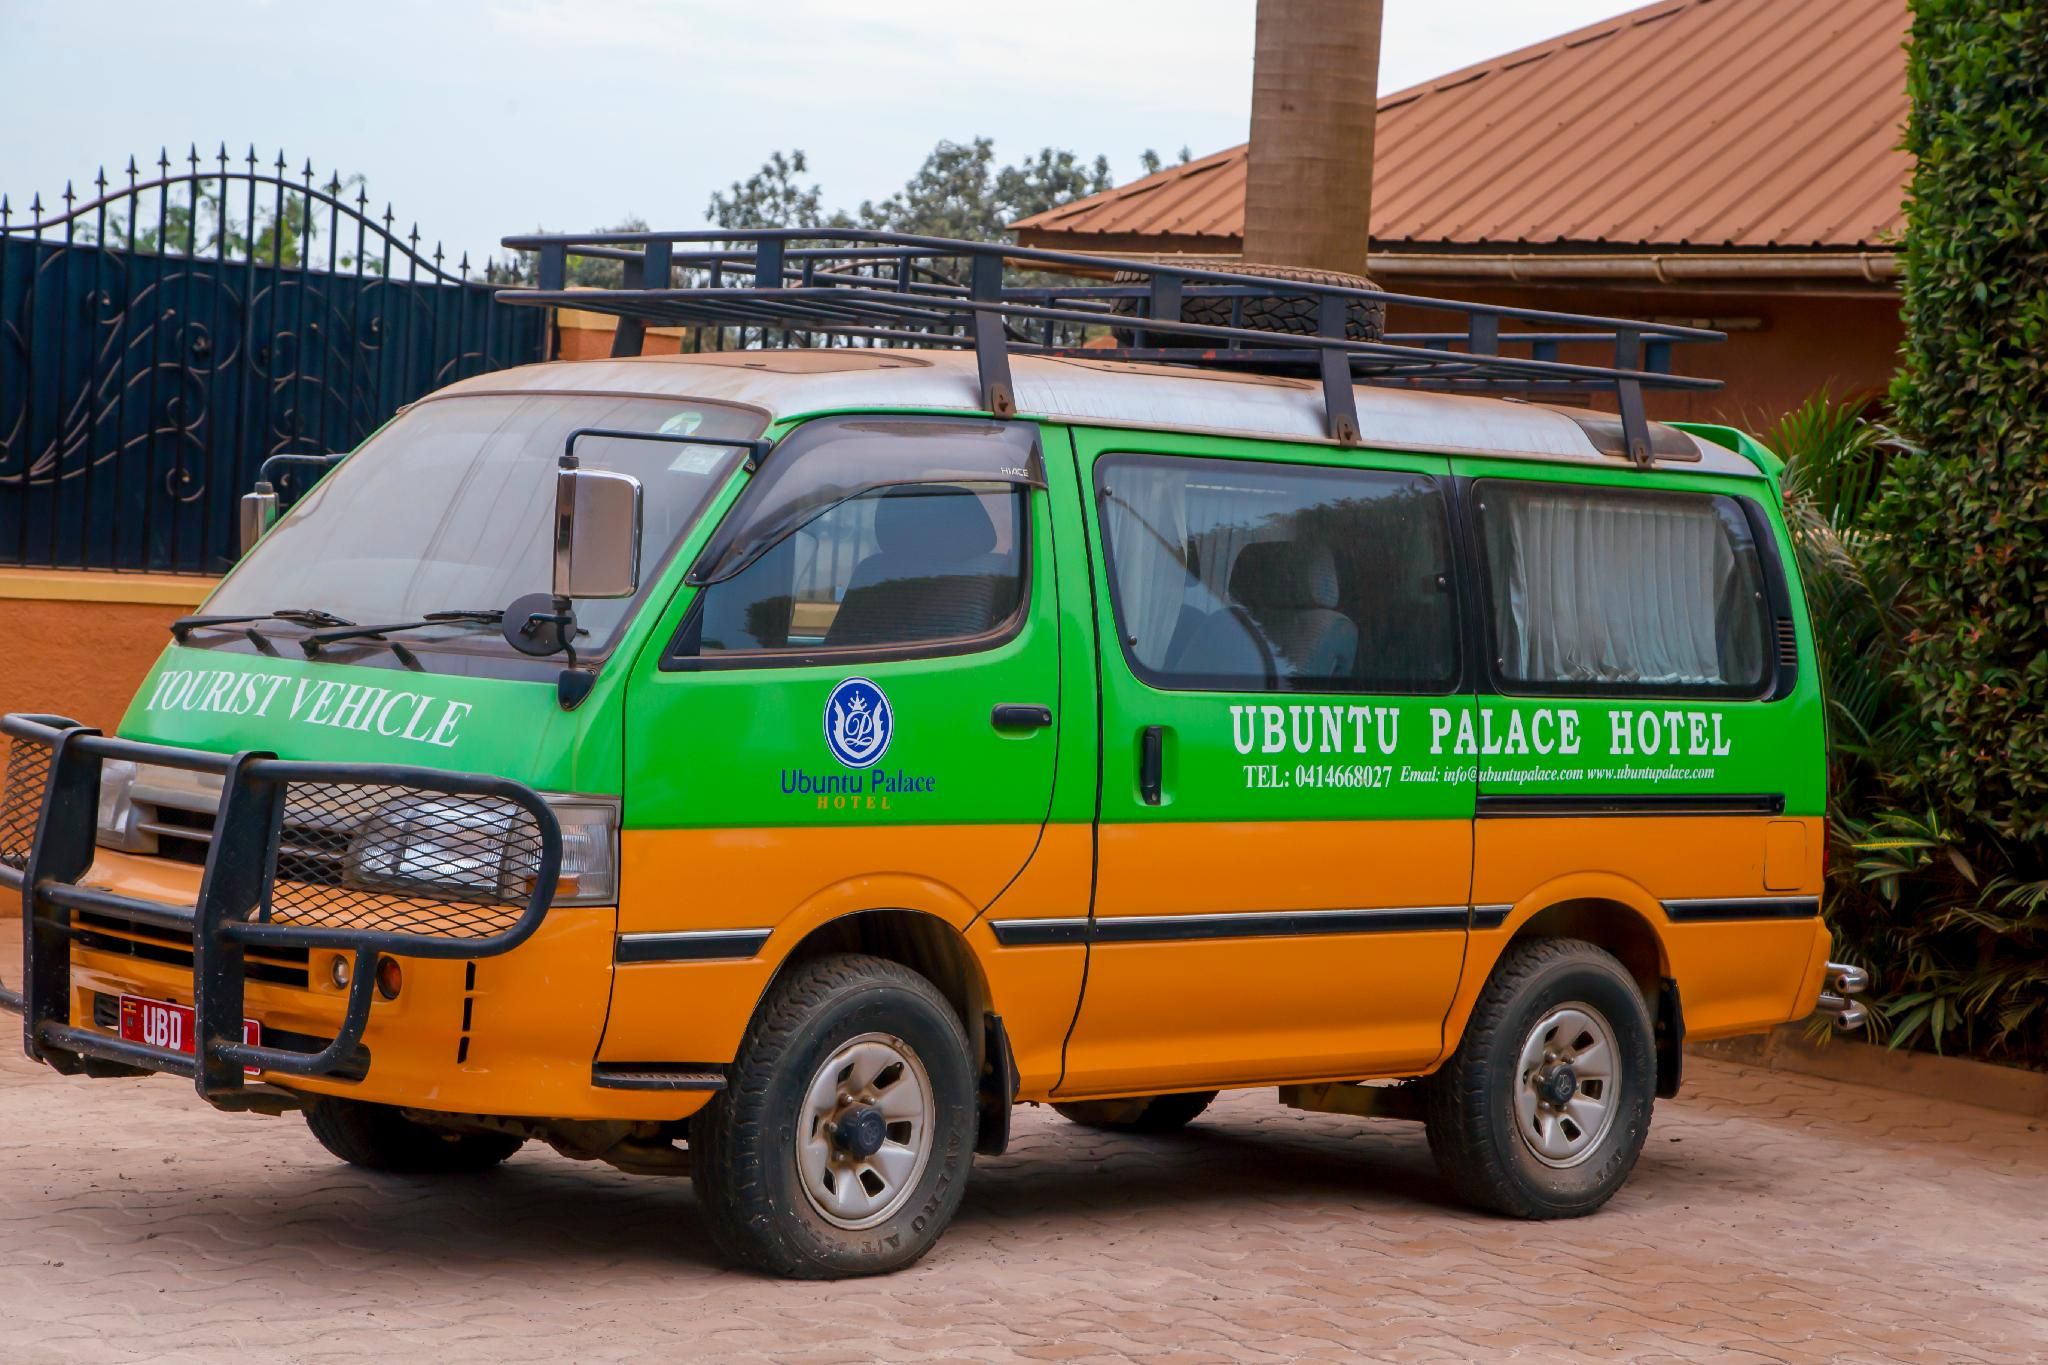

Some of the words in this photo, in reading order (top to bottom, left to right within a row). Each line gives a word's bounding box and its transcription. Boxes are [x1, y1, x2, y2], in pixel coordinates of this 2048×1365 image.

[1001, 467, 1029, 477] HIACE
[146, 669, 291, 718] TOURIST
[288, 678, 472, 748] VEHICLE
[1230, 705, 1400, 755] UBUNTU
[1429, 708, 1581, 755] PALACE
[1608, 710, 1732, 756] HOTEL
[781, 769, 863, 794] Ubuntu
[871, 769, 936, 793] Palace
[1243, 764, 1290, 788] TEL:
[1295, 764, 1393, 788] 0414668027
[1400, 765, 1441, 783] Email:
[1443, 765, 1583, 786] info@ubuntupalace.com
[1587, 763, 1715, 784] www.ubuntupalace.com
[817, 796, 891, 809] HOTEL
[143, 1004, 181, 1050] UBD
